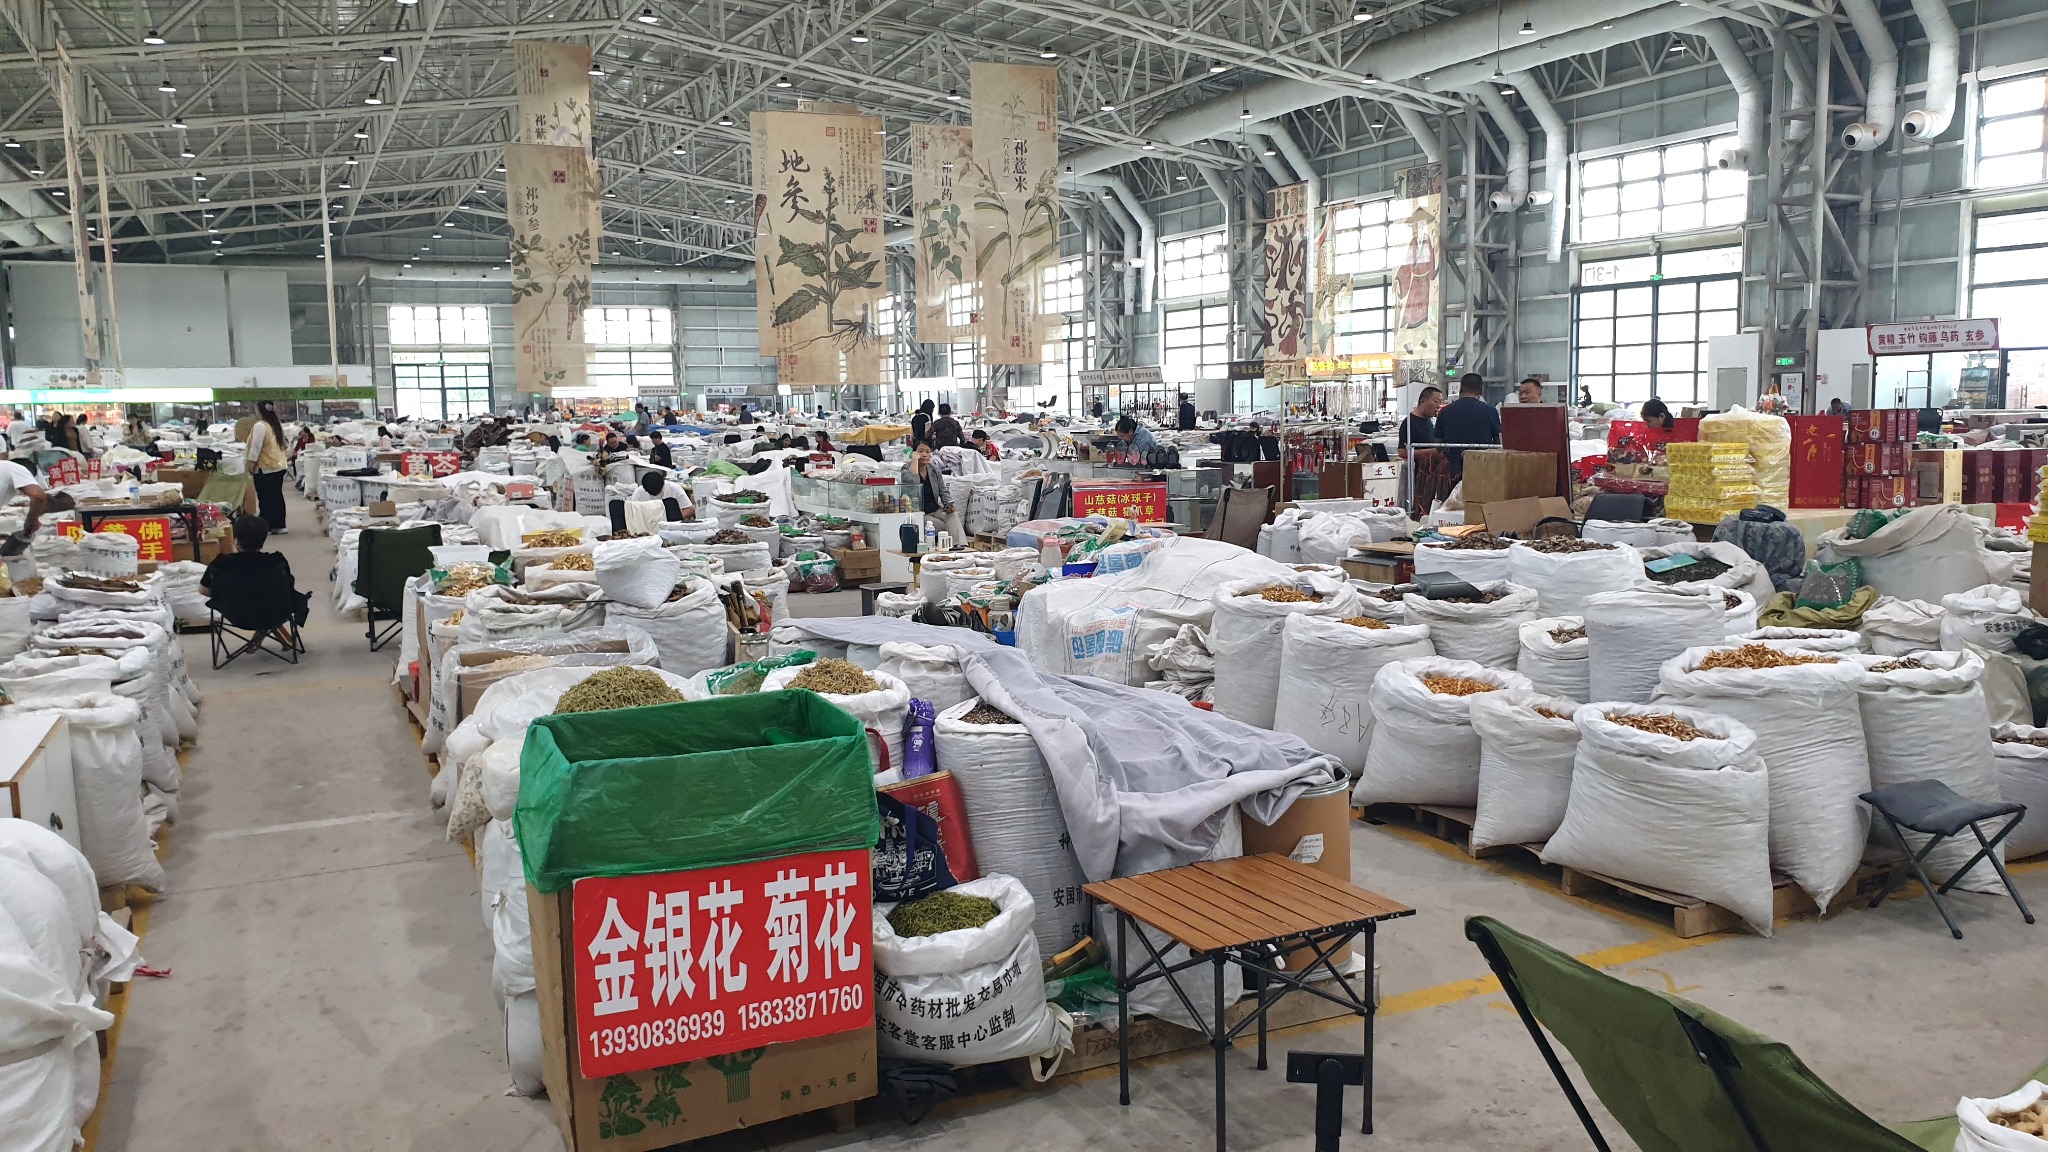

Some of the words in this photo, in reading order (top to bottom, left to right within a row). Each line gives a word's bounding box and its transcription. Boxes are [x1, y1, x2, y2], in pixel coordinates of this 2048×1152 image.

[535, 114, 547, 144] 祁紫
[1013, 138, 1028, 193] 祁薏米
[524, 186, 540, 232] 祁沙参
[1878, 333, 1895, 346] 黄精
[1898, 333, 1915, 344] 玉竹
[1941, 330, 1959, 343] 乌药
[1965, 329, 1985, 342] 玄参
[405, 453, 458, 477] 黄芩
[1084, 492, 1156, 506] 山慈菇(冰球子)
[139, 521, 165, 561] 佛手
[587, 878, 748, 1017] 金银花
[764, 861, 862, 984] 菊花
[589, 1009, 725, 1059] 13930836939
[738, 983, 863, 1032] 15833871760
